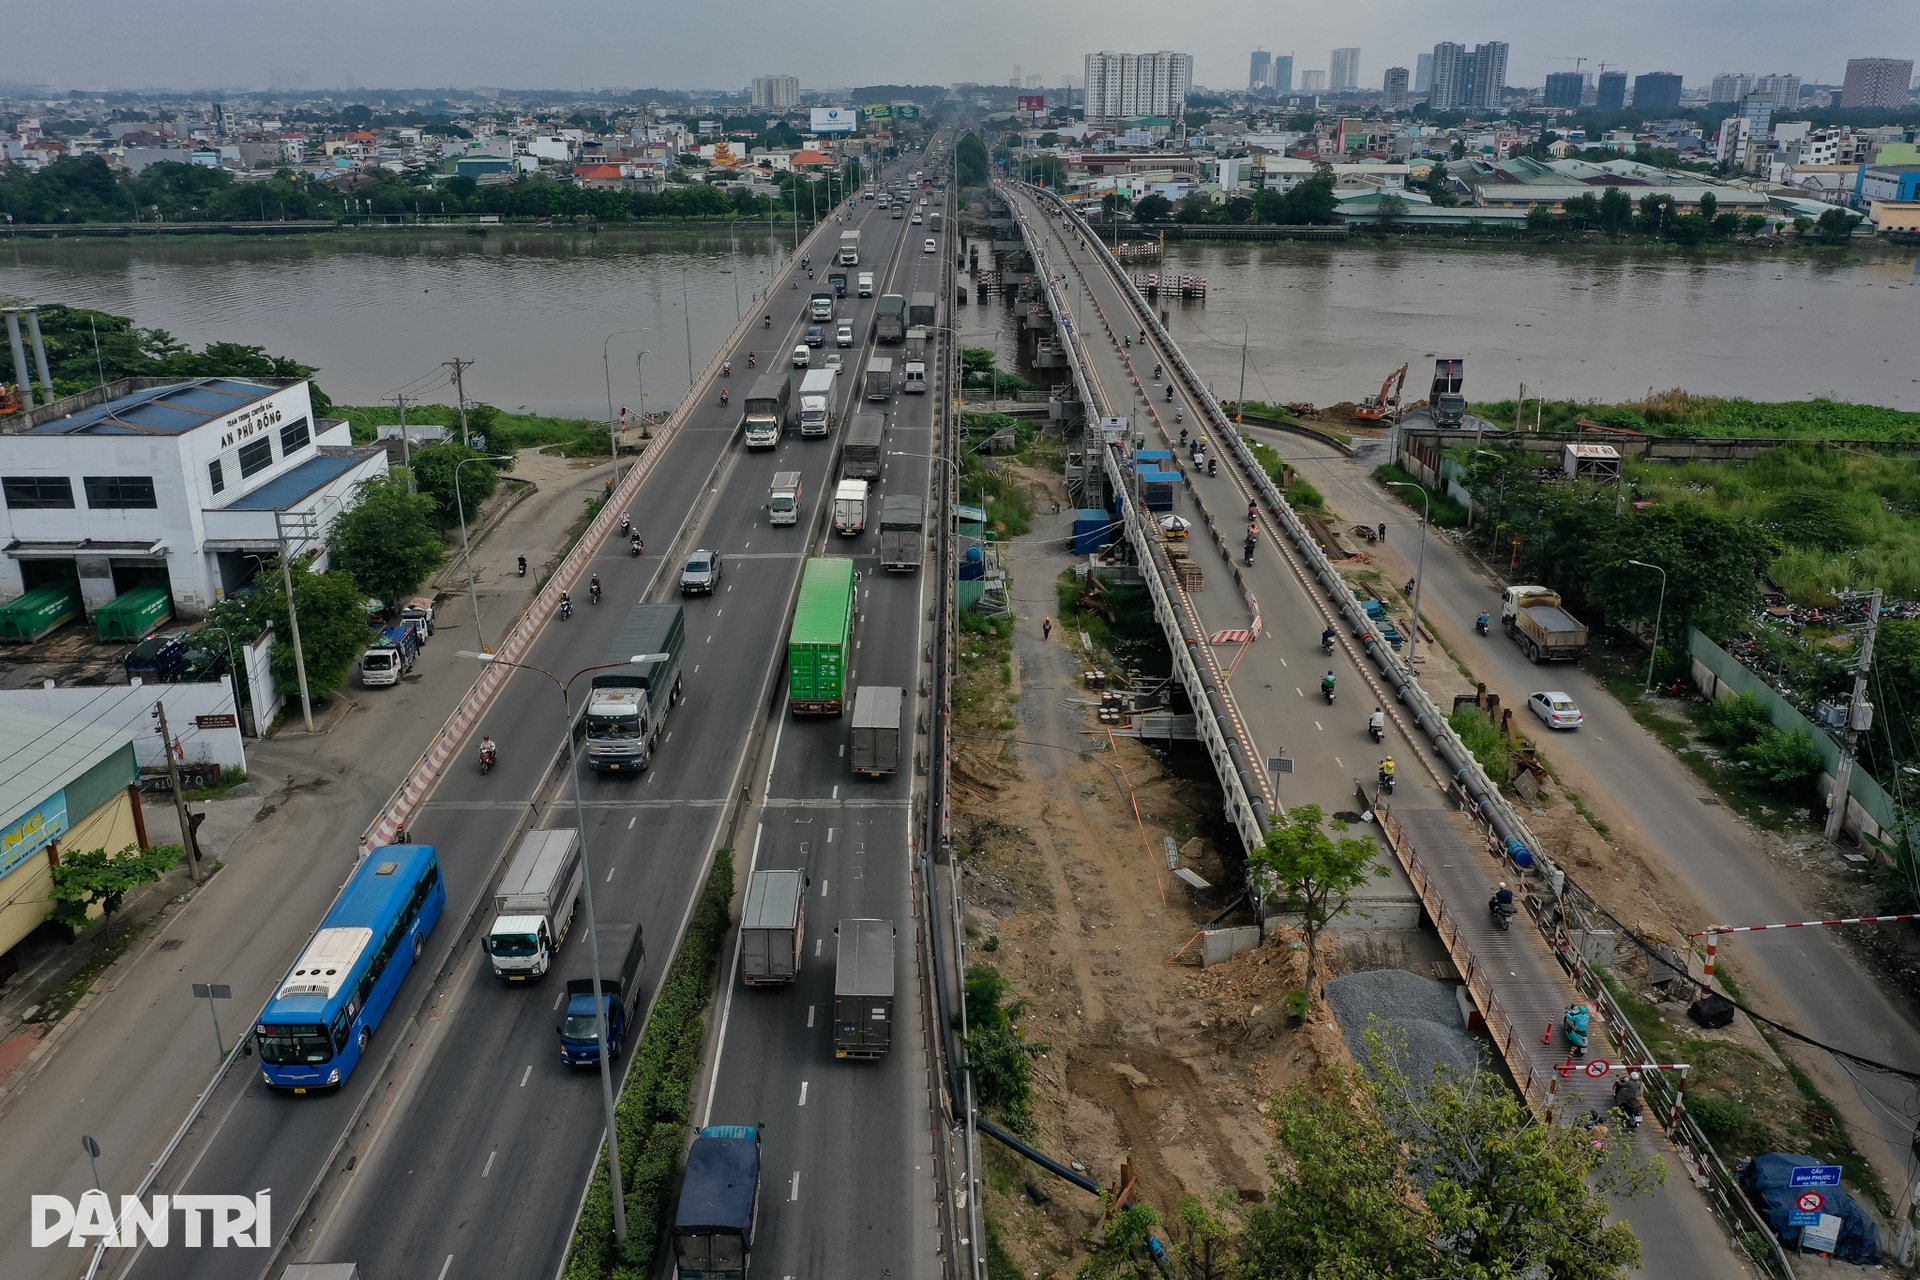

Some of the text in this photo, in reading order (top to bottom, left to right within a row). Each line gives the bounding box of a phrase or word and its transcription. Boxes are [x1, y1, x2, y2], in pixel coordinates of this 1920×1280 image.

[221, 410, 281, 449] AN PHÚ ĐÔNG
[0, 812, 45, 853] NG
